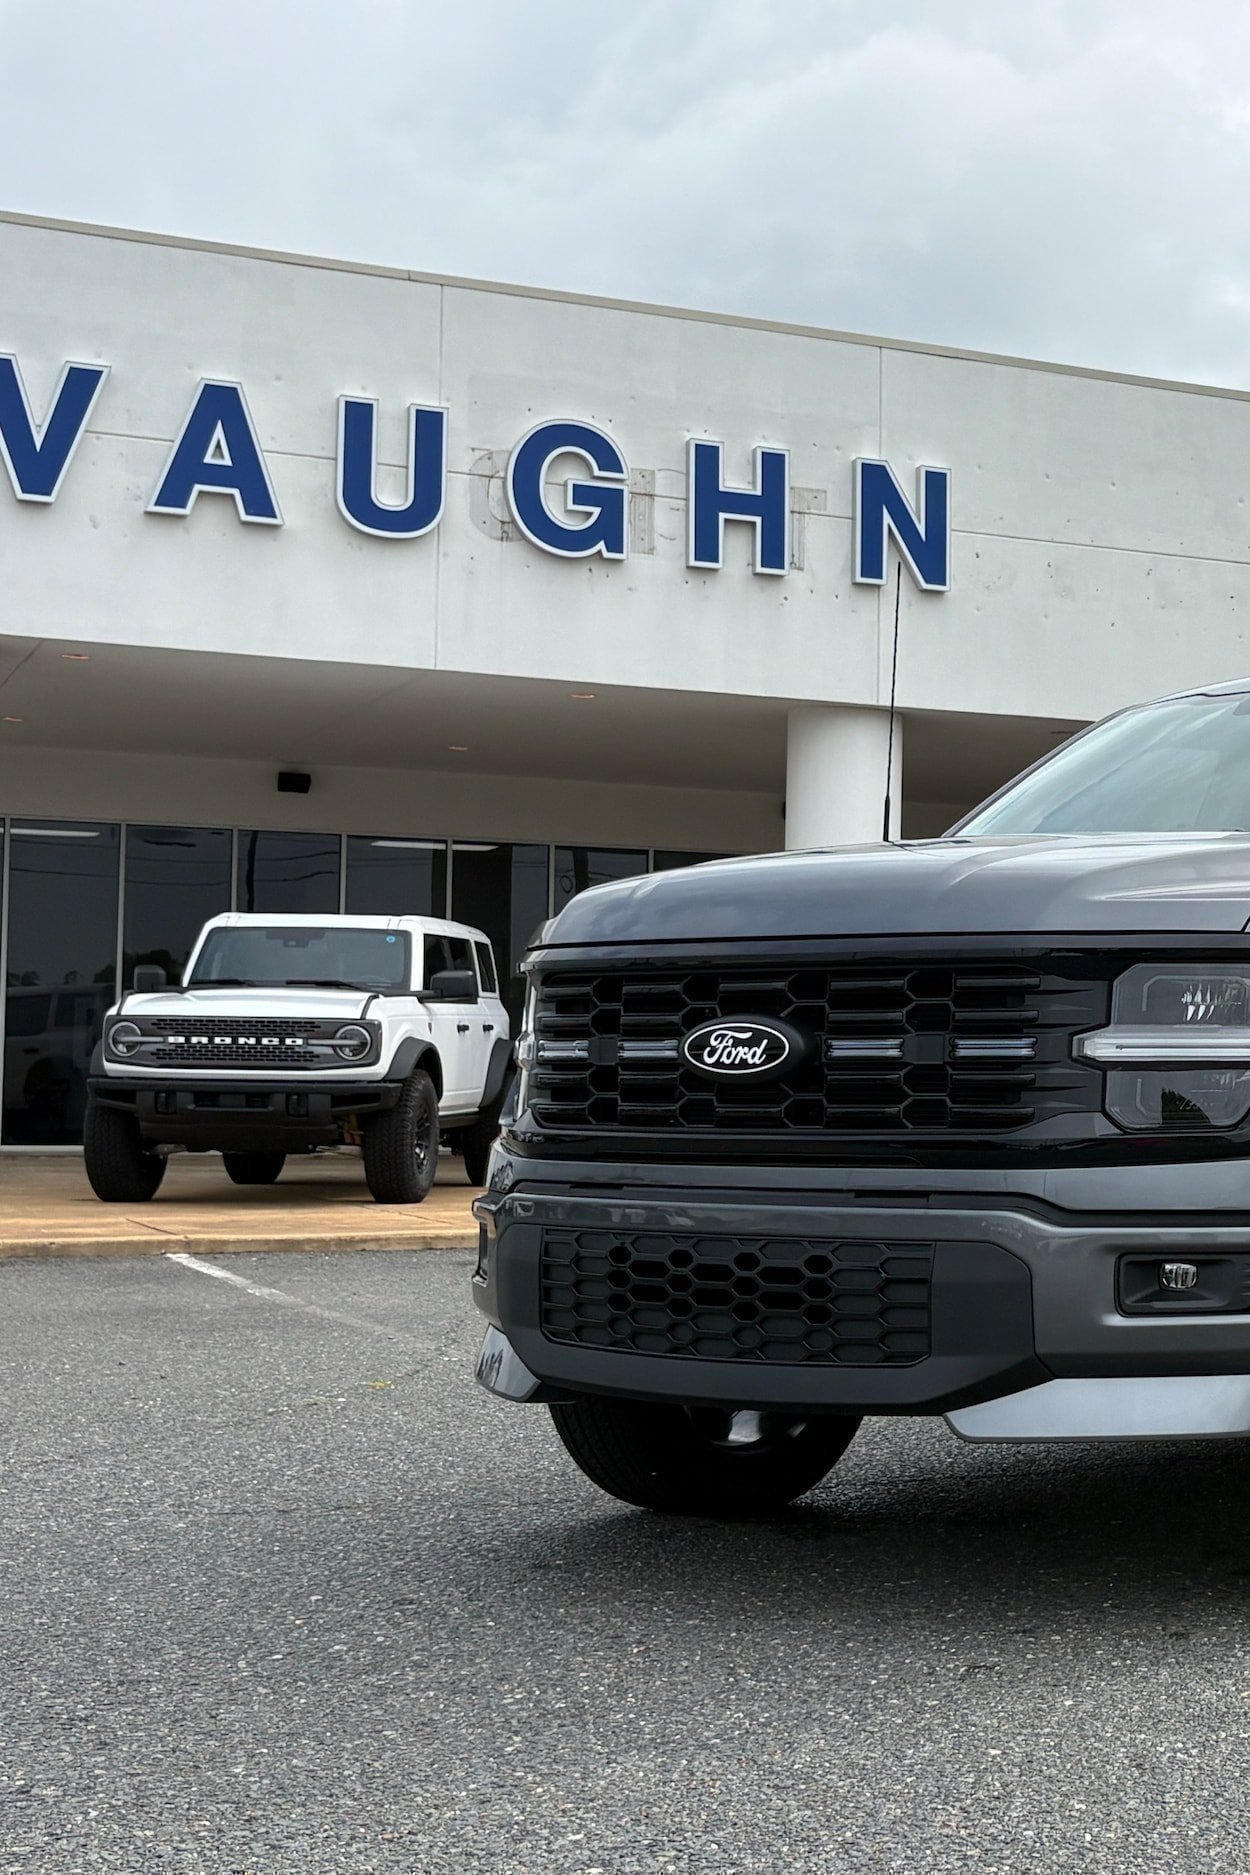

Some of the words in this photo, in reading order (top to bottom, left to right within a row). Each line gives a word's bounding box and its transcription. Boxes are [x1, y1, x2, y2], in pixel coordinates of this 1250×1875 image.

[0, 352, 951, 592] VAUGHN
[167, 1035, 304, 1046] BRONCO
[703, 1029, 768, 1065] Ford
